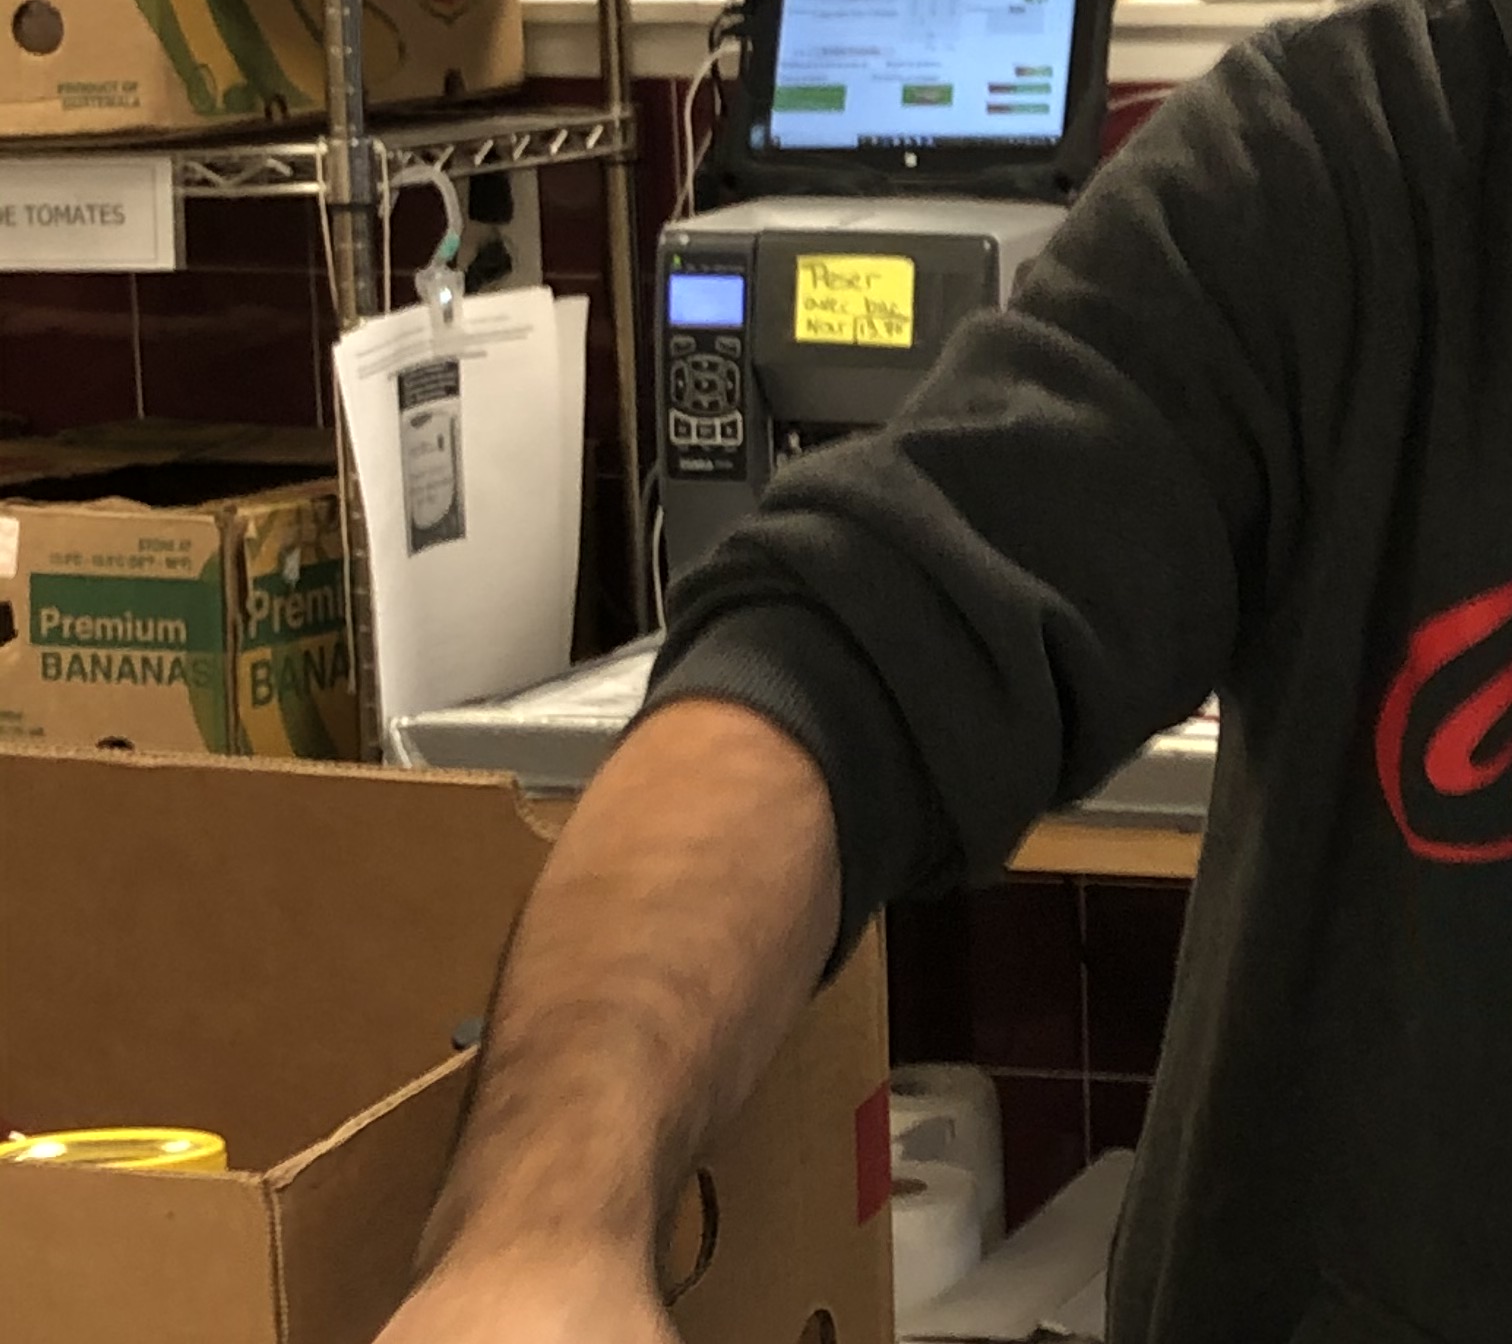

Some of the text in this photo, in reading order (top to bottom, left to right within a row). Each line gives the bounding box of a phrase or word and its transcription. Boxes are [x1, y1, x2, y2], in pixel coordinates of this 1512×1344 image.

[24, 203, 126, 227] TOMATES
[40, 606, 187, 644] Premium
[251, 642, 350, 706] BANA
